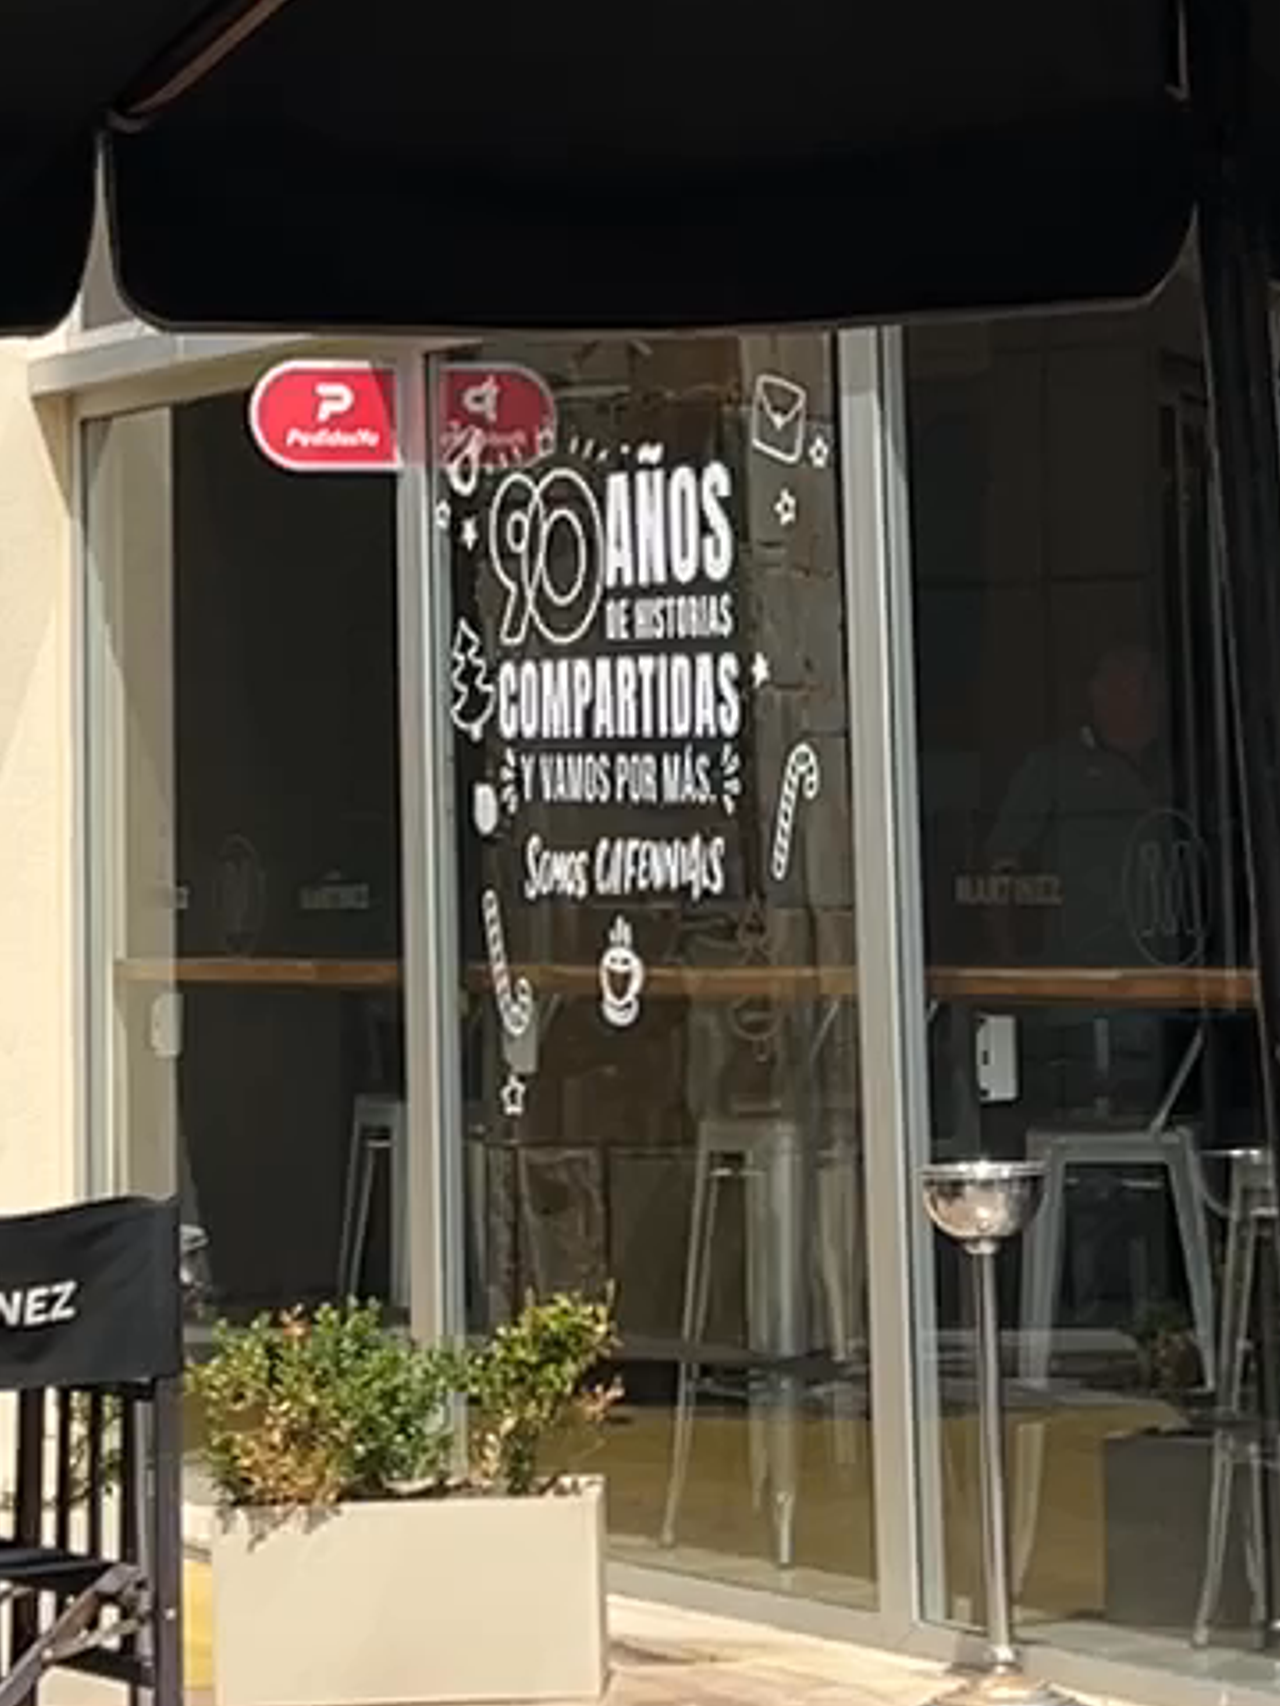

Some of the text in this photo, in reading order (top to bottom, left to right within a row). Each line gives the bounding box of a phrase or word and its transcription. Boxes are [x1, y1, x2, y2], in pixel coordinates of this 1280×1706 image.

[489, 442, 733, 645] 90 AÑOS
[606, 593, 733, 639] DE HISTORIAS
[499, 653, 740, 739] COMPARTIDAS
[521, 742, 718, 804] Y VAMOS POR MÁS.
